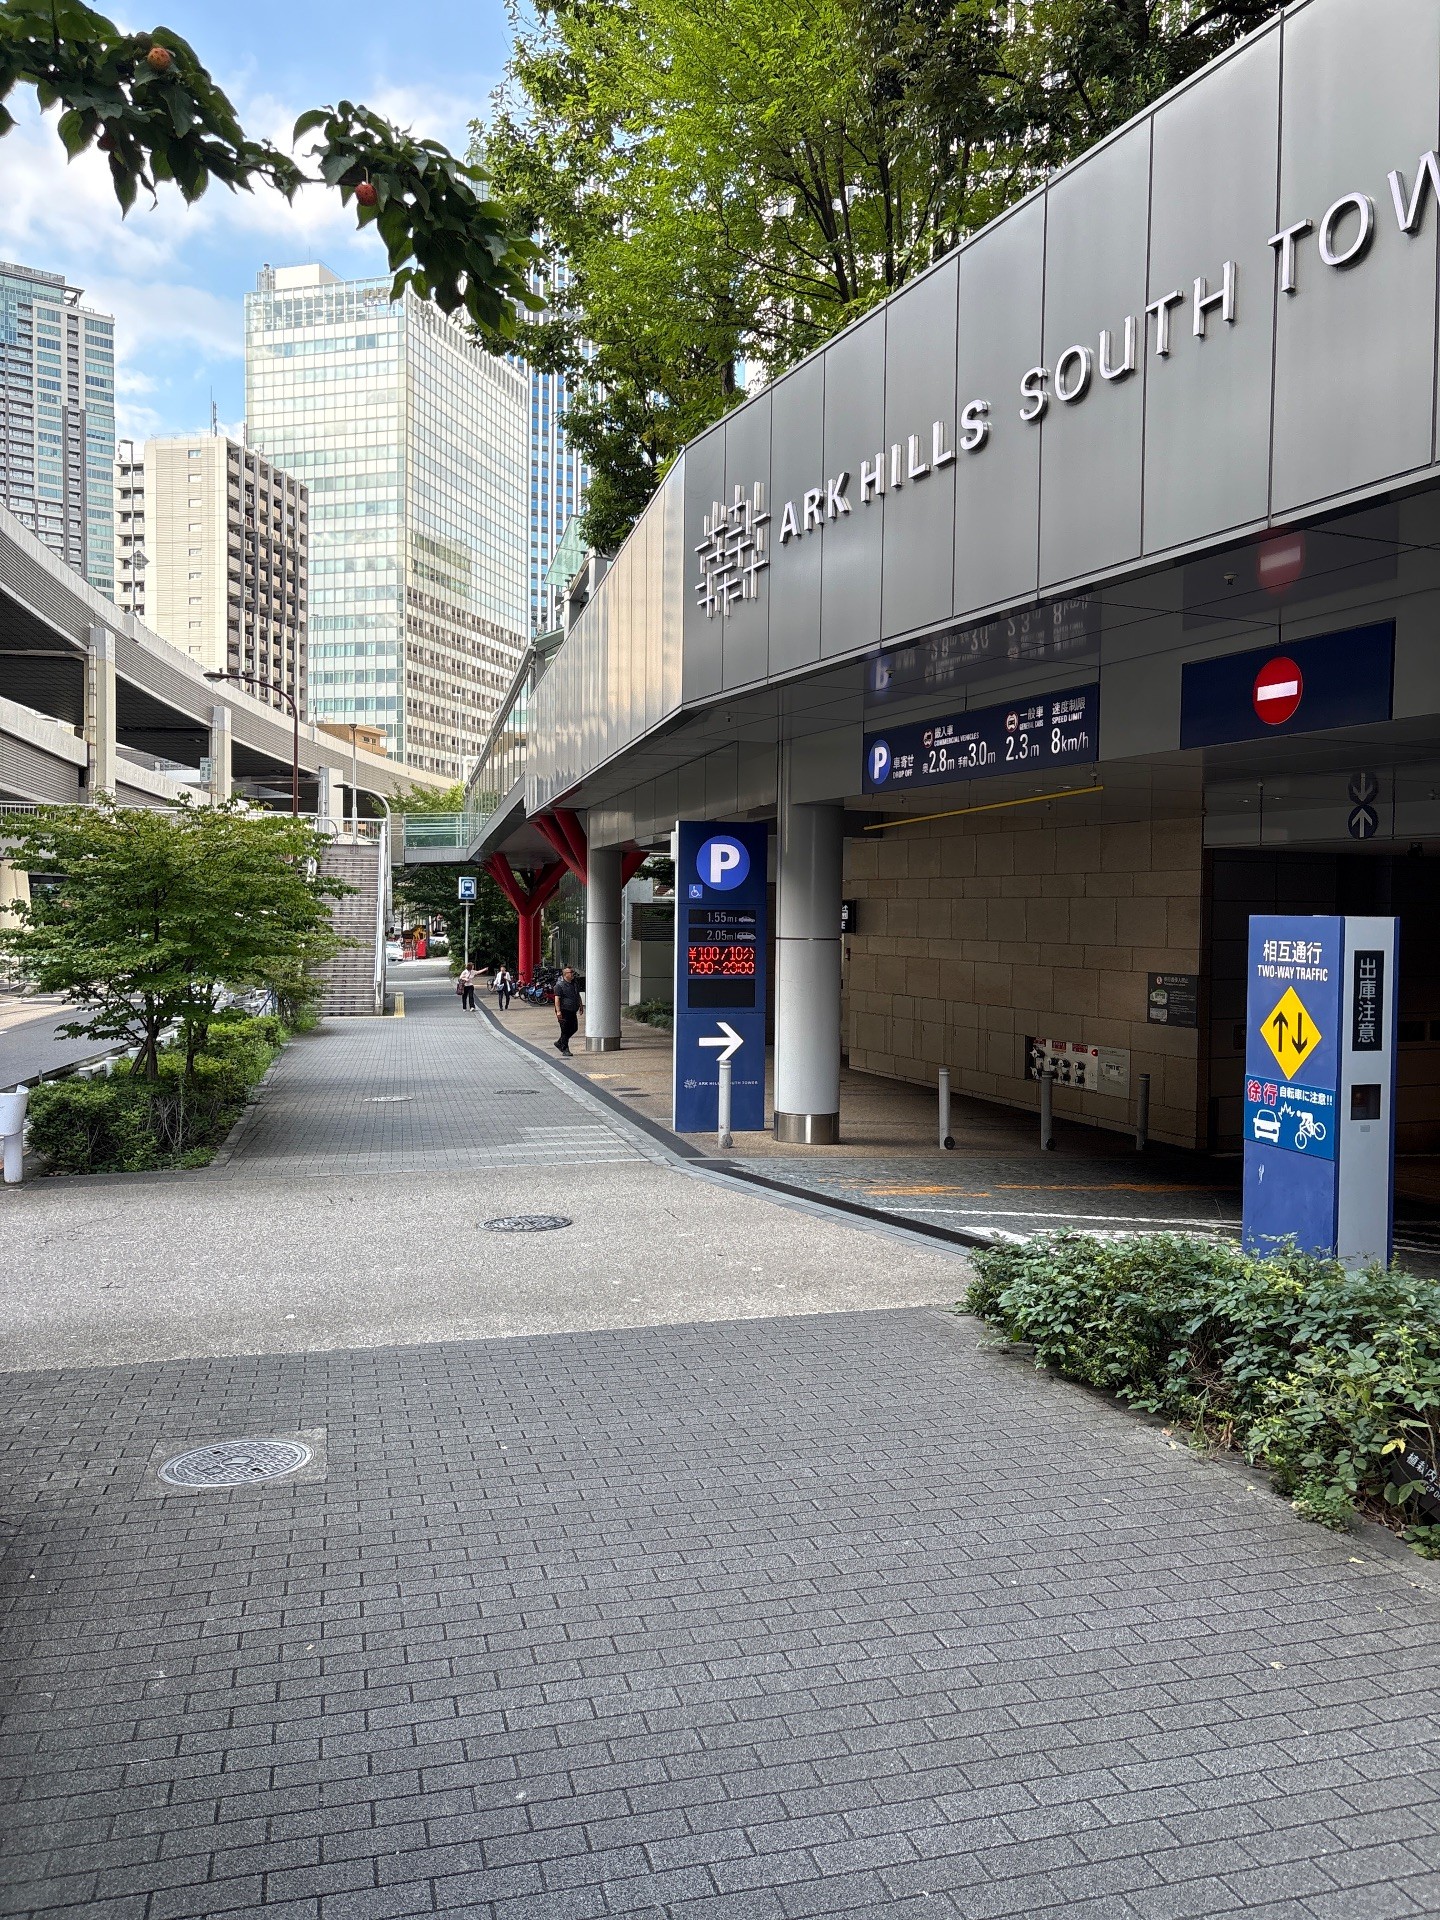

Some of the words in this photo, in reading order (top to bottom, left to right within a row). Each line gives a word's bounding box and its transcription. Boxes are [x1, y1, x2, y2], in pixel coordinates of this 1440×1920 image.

[779, 472, 852, 544] ARK
[860, 399, 992, 504] HILLS
[1019, 260, 1237, 421] SOUTH
[1019, 705, 1044, 720] 一般車
[1051, 696, 1086, 716] 速度制限
[1051, 714, 1068, 725] SPEED
[1068, 711, 1083, 722] LIMIT
[1051, 727, 1089, 754] 8km/h
[873, 746, 888, 780] P
[893, 754, 915, 770] 車寄せ
[710, 843, 741, 883] P
[706, 911, 734, 923] 1.55m
[706, 929, 734, 941] 2.05m
[1263, 940, 1322, 964] 相互通行
[1257, 964, 1295, 979] TWO-WAY
[1295, 967, 1328, 982] TRAFFIC
[1357, 957, 1376, 1043] 出庫注意
[1247, 1079, 1278, 1106] 徐行
[1279, 1086, 1333, 1106] 自転車に注意!!
